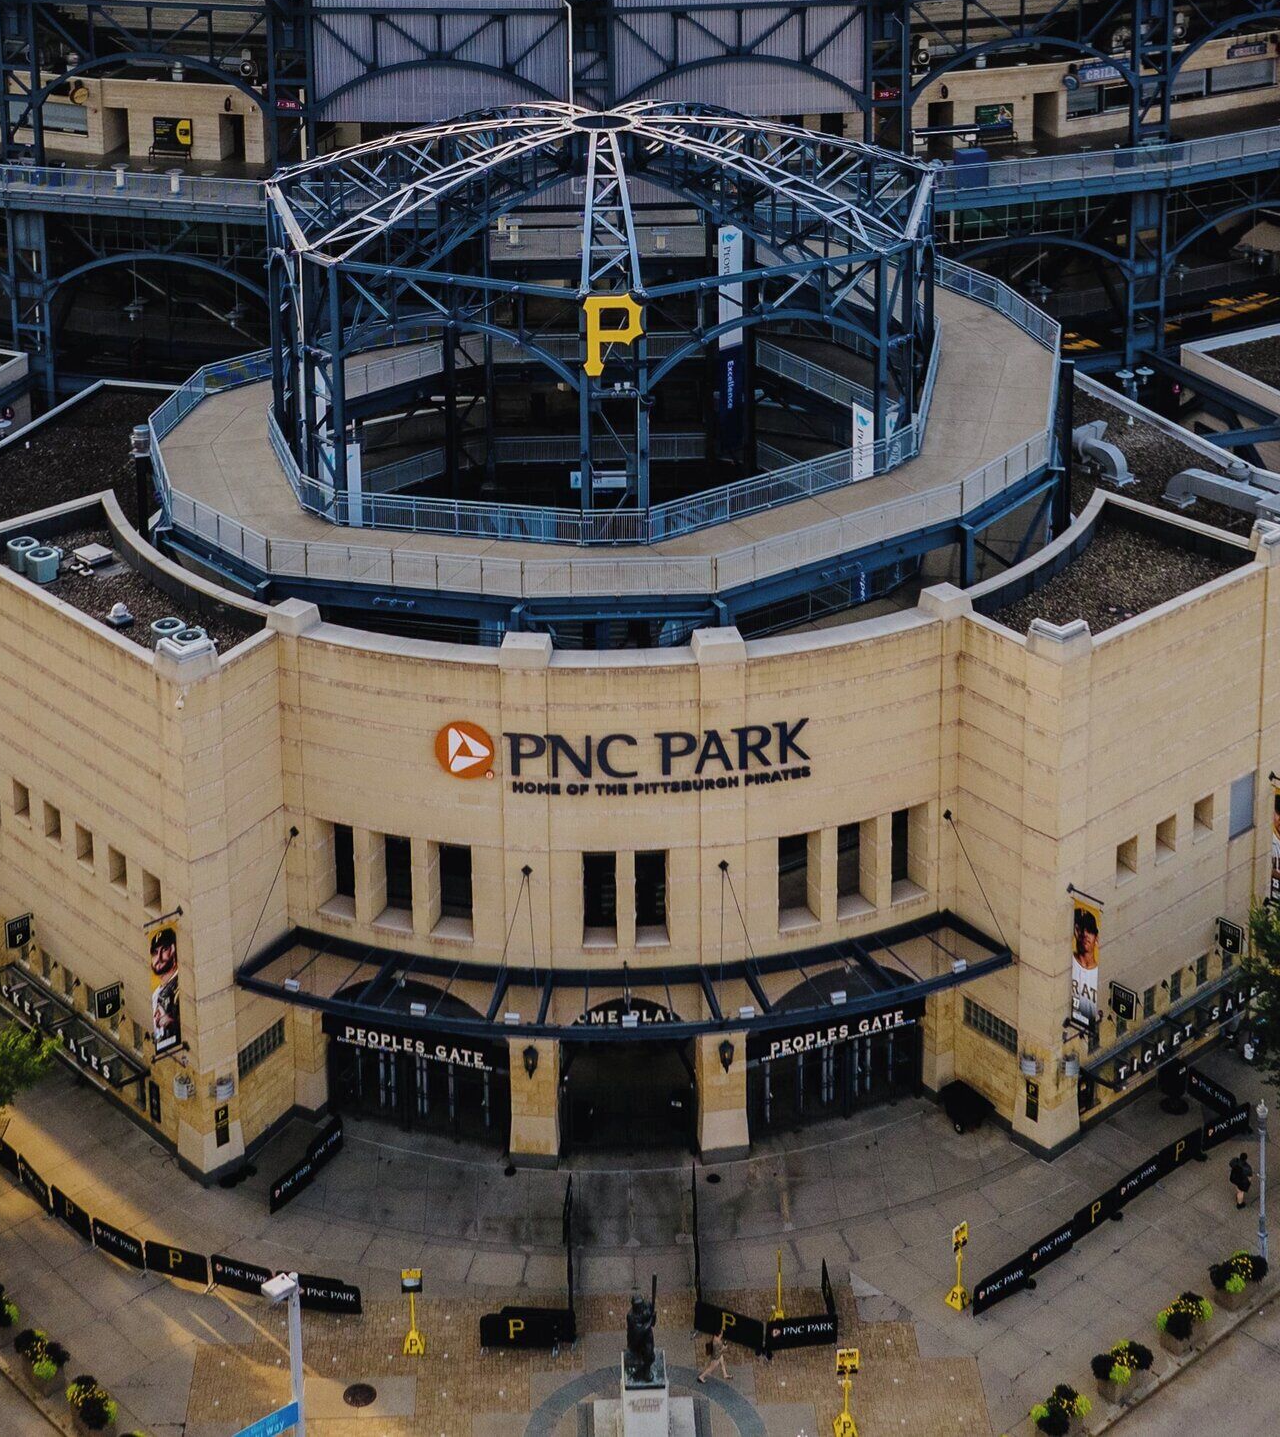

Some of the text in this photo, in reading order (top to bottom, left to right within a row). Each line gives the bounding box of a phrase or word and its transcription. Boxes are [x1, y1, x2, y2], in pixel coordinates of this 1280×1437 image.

[583, 293, 644, 376] P
[504, 717, 812, 778] PNC PARK
[512, 765, 812, 796] HOME OF THE PITTSBURGH PIRATES
[16, 933, 23, 945] P
[1226, 939, 1232, 948] P
[106, 1003, 113, 1015] P
[1119, 1005, 1127, 1015] P
[1211, 987, 1258, 1020] SALE
[771, 1010, 904, 1058] PEOPLES GATE
[57, 1029, 111, 1080] SALES
[345, 1026, 425, 1054] PEOPLES
[435, 1045, 484, 1066] GATE
[1119, 1023, 1193, 1080] TICKET
[1028, 1085, 1035, 1095] P
[1198, 1079, 1231, 1108] PNC PARK
[218, 1110, 226, 1120] P
[1214, 1111, 1248, 1135] PNC PARK
[314, 1143, 327, 1159] PNC
[1175, 1140, 1185, 1162] P
[281, 1162, 311, 1192] PNC PARK
[1126, 1164, 1158, 1193] PNC PARK
[1090, 1201, 1101, 1224] P
[103, 1230, 138, 1254] PNC PARK
[1038, 1230, 1072, 1257] PNC PARK
[169, 1249, 182, 1268] P
[224, 1267, 268, 1283] PNC PARK
[986, 1268, 1025, 1296] PNC PARK
[307, 1288, 356, 1302] PNC PARK
[951, 1290, 958, 1302] P
[961, 1293, 968, 1307] P
[509, 1319, 525, 1339] P
[722, 1312, 737, 1331] P
[783, 1322, 833, 1336] PNC PARK
[409, 1339, 417, 1351] P
[843, 1421, 852, 1435] P
